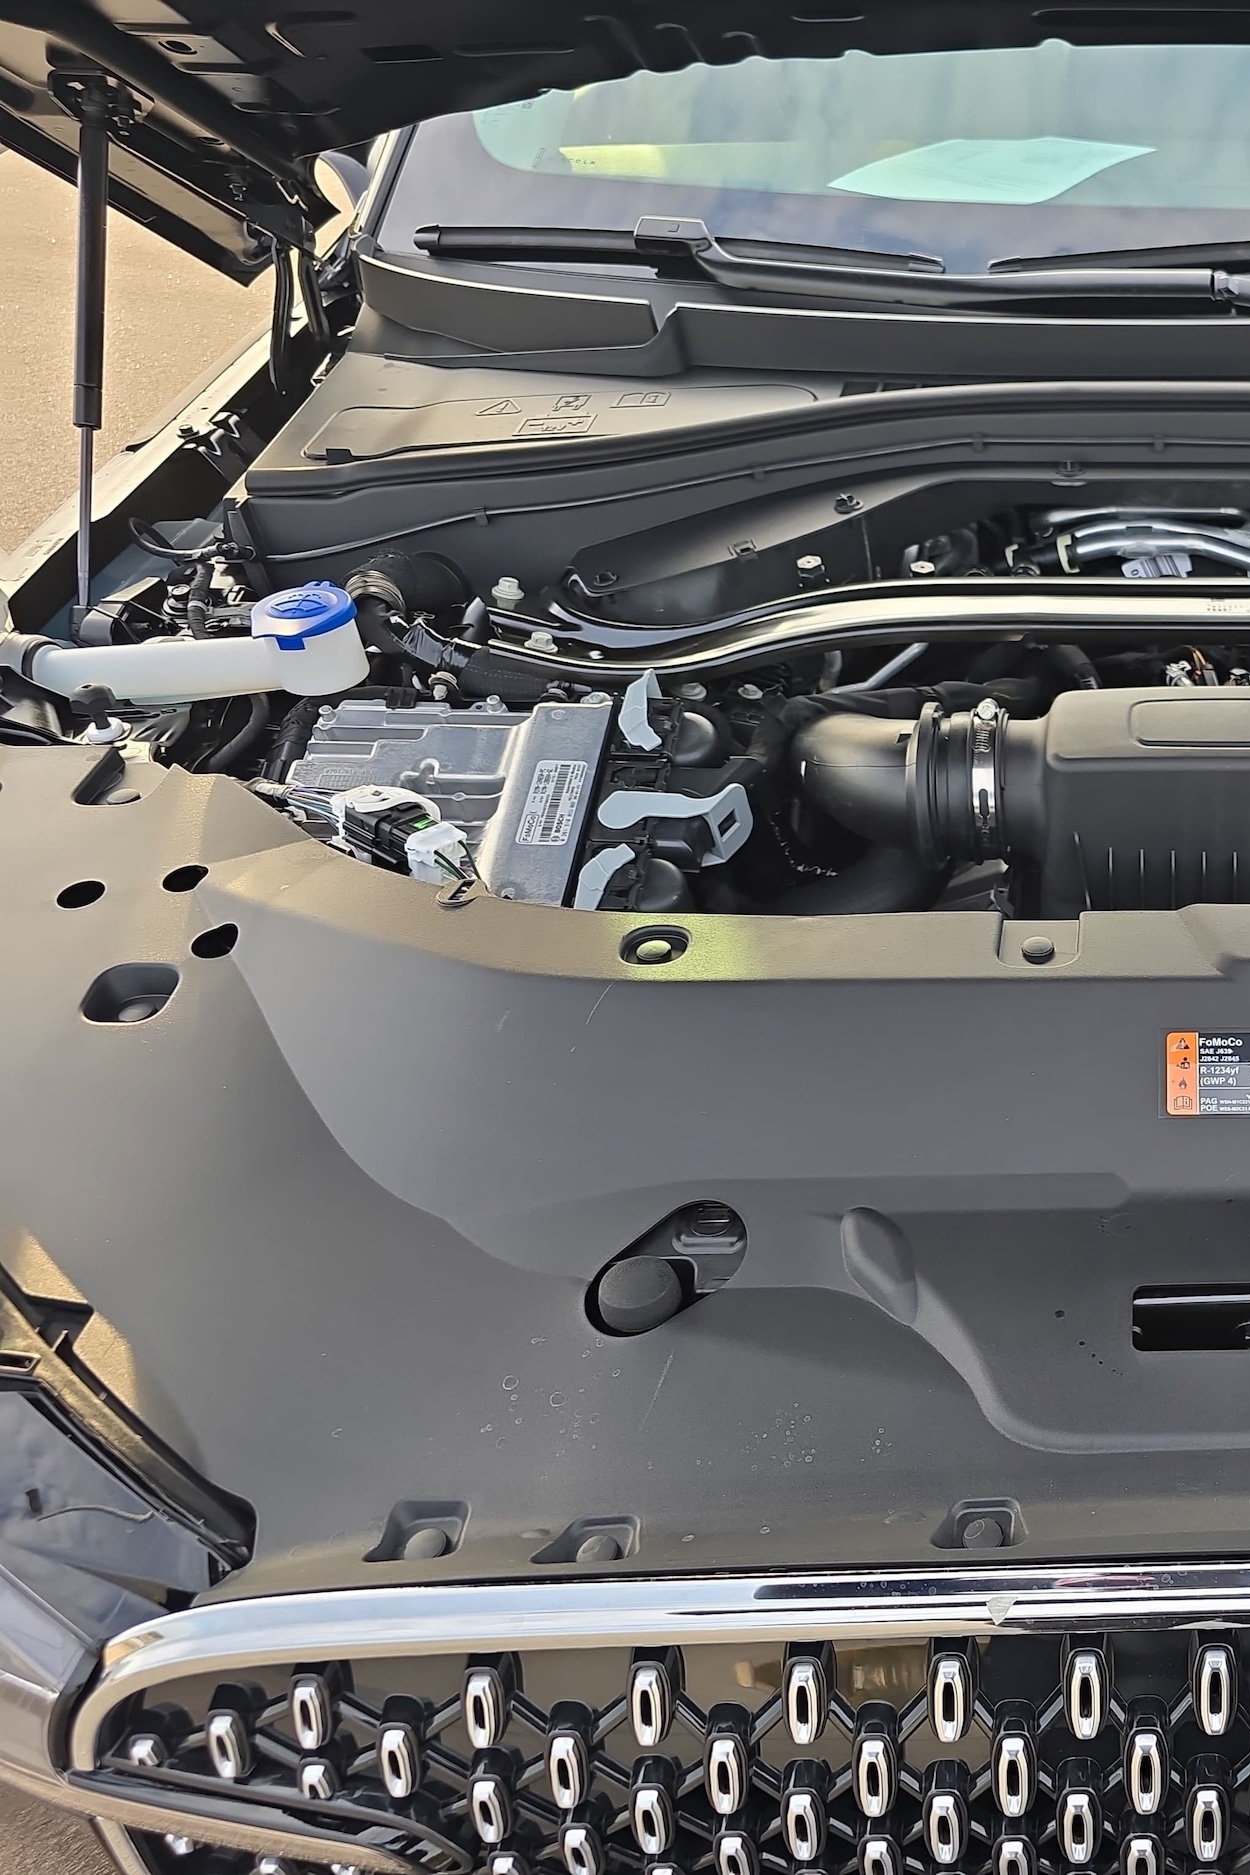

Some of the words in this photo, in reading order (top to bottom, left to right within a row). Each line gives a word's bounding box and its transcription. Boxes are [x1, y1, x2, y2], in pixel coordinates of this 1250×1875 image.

[522, 816, 537, 842] FoMoCo
[554, 814, 566, 834] BOSCH
[1199, 1037, 1243, 1047] FoMoCo
[1200, 1066, 1239, 1076] R-1234yf
[1200, 1076, 1226, 1086] (GWP
[1227, 1076, 1237, 1086] 4)
[1200, 1097, 1218, 1105] PAG
[1200, 1104, 1218, 1112] POE
